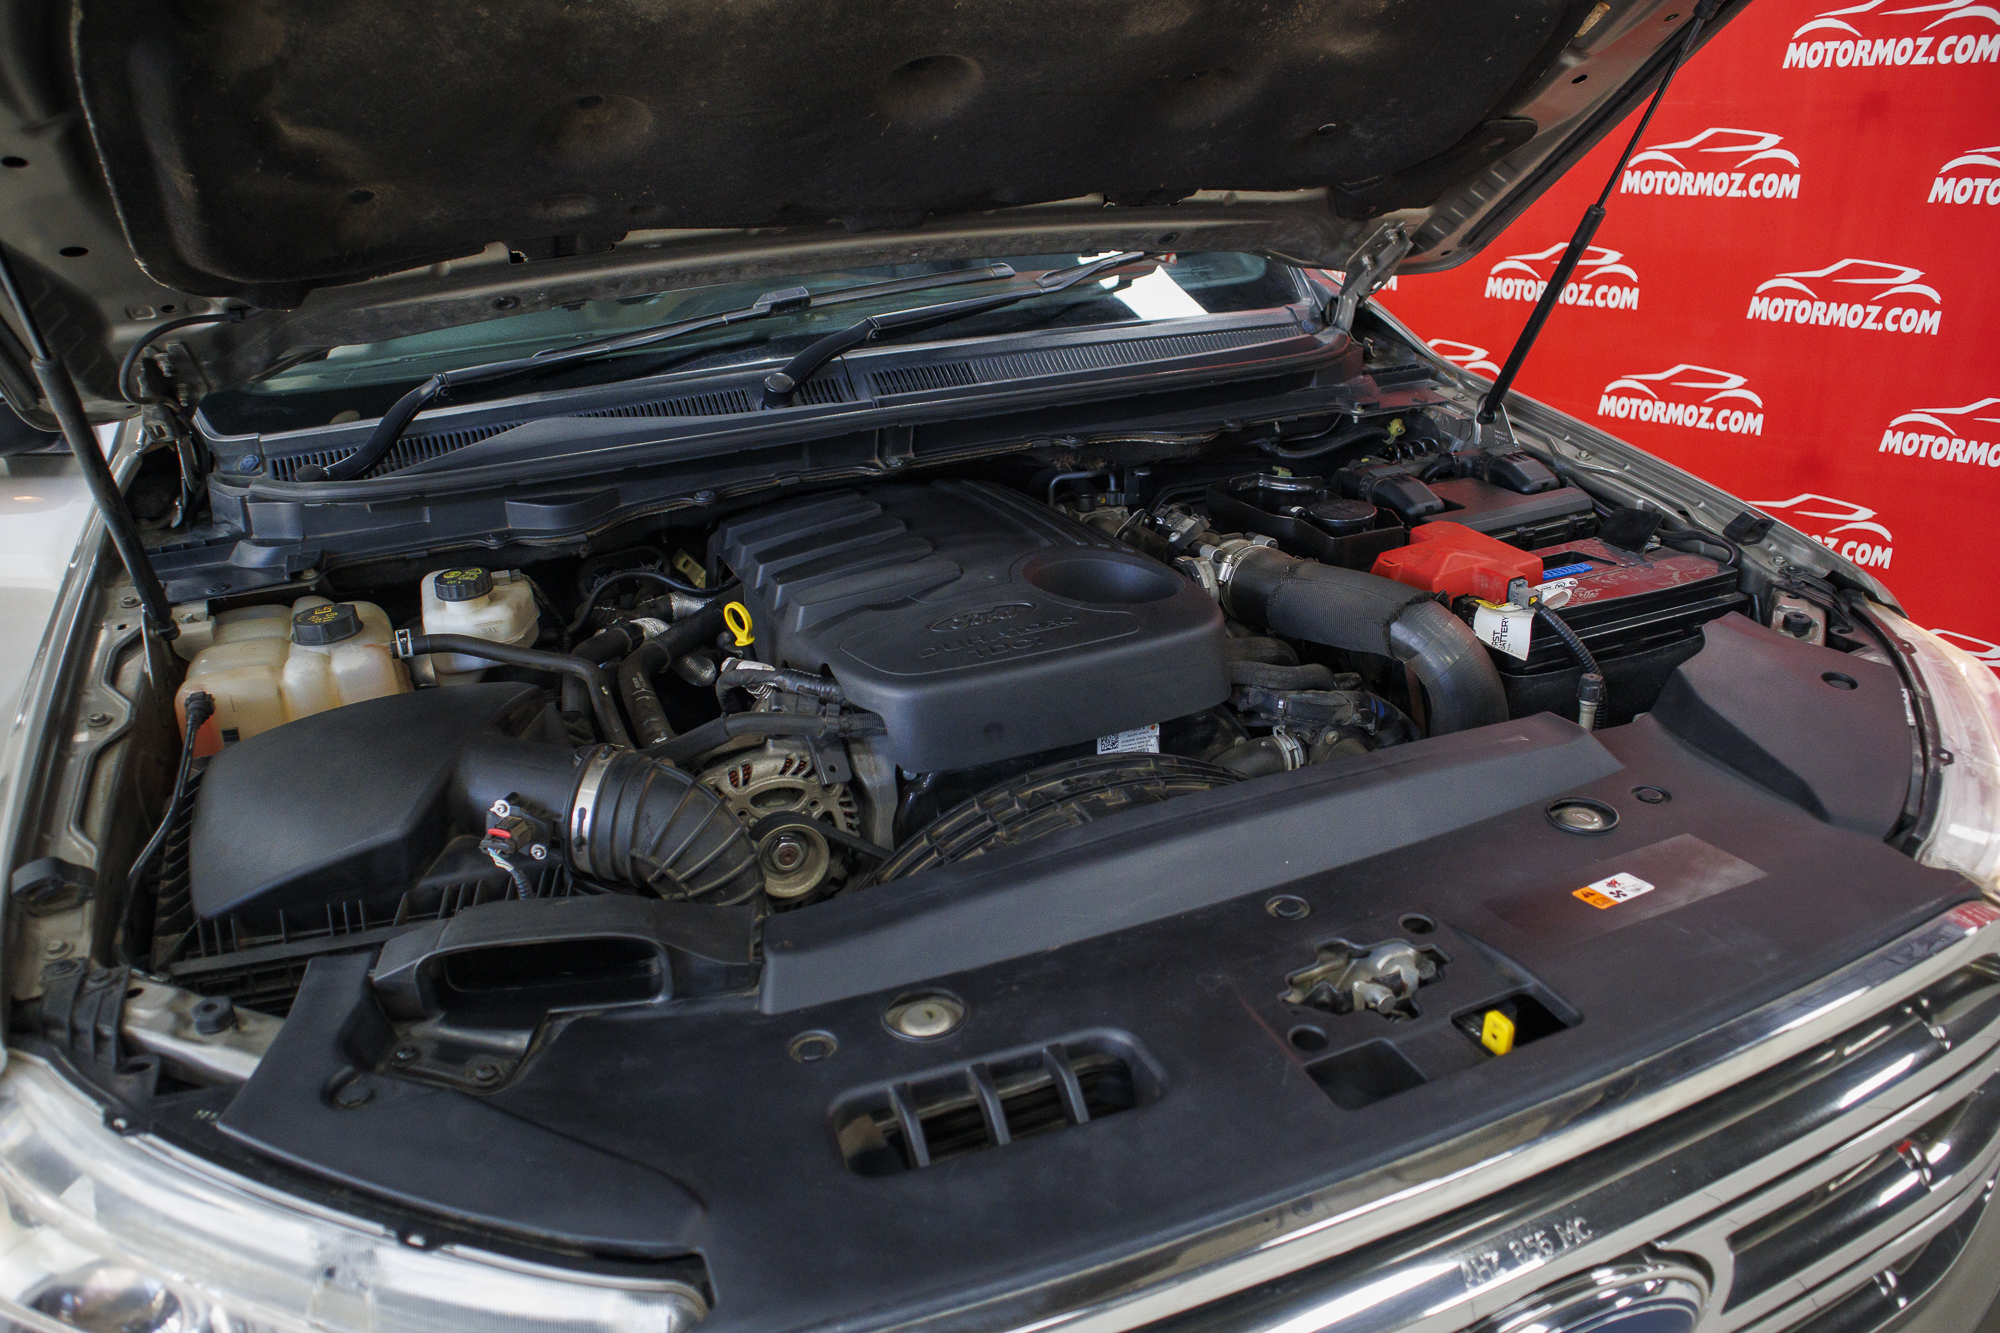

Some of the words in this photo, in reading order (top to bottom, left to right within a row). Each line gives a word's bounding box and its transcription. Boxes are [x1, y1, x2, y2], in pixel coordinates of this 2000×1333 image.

[1782, 33, 2000, 69] MOTORMOZ.COM
[1619, 170, 1801, 199] MOTORMOZ.COM
[1746, 295, 1942, 336] MOTORMOZ.COM
[1597, 394, 1764, 437] MOTORMOZ.COM
